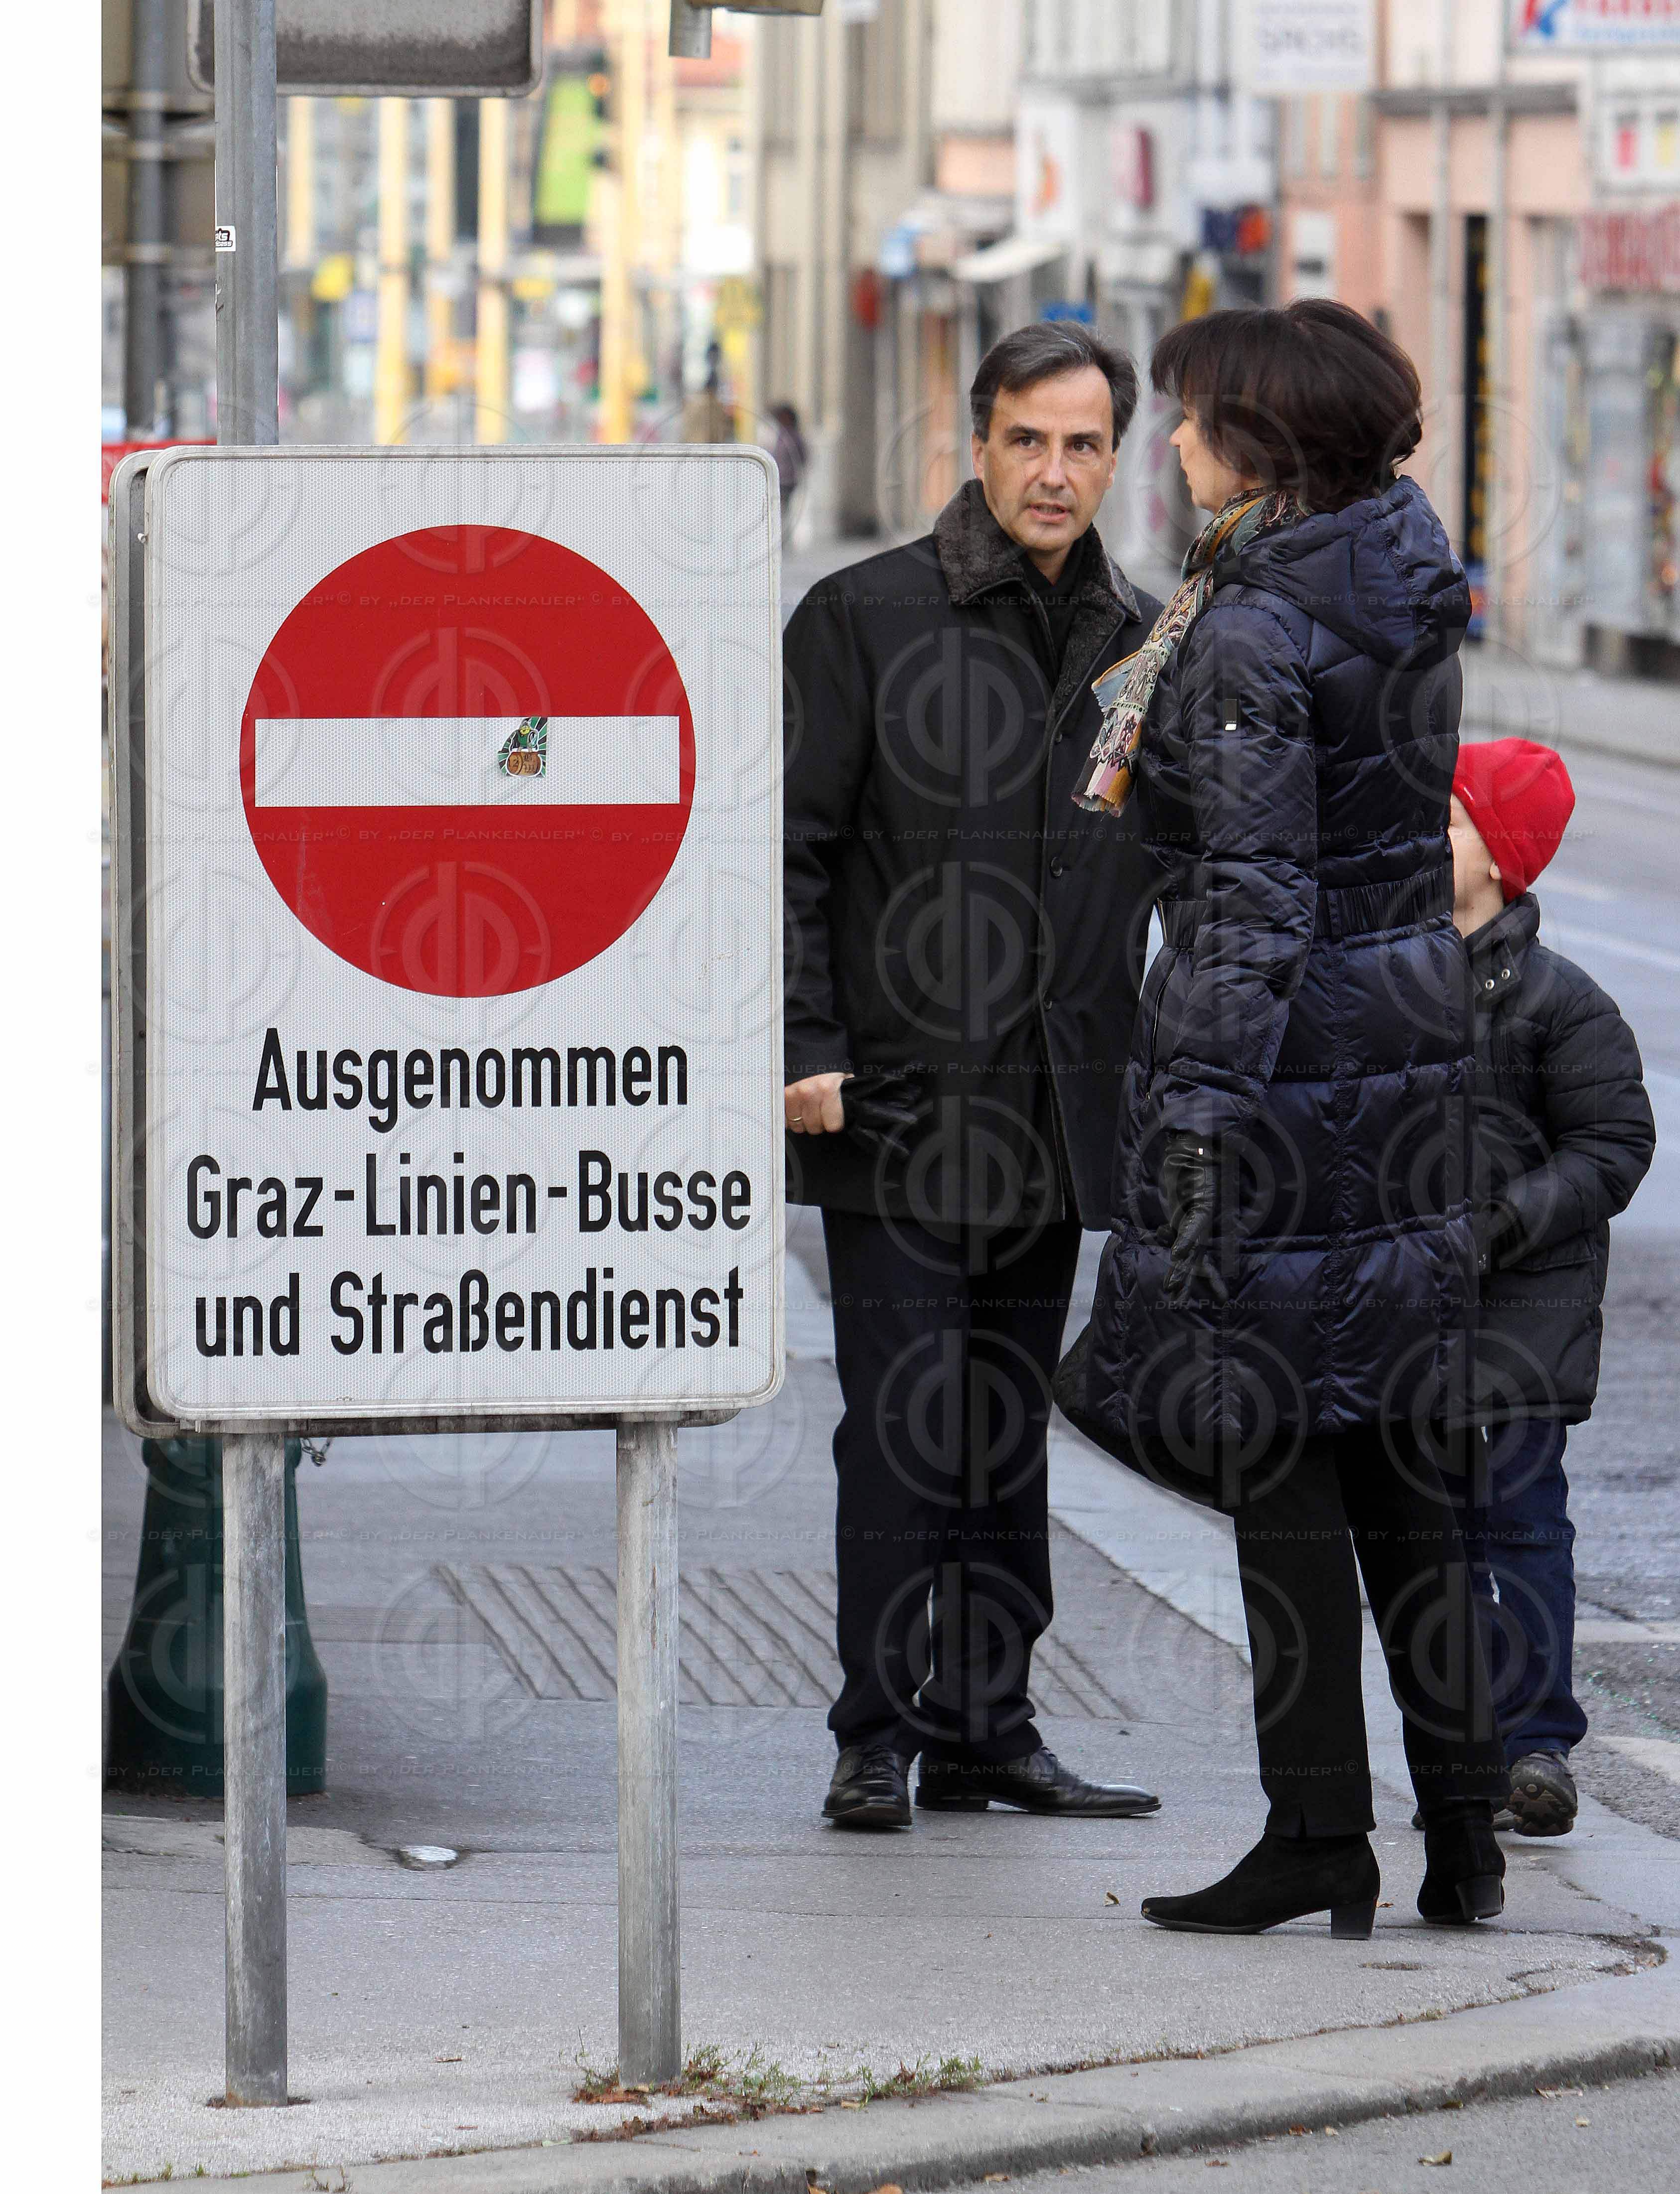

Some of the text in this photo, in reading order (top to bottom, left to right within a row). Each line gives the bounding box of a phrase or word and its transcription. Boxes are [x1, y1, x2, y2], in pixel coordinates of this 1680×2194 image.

[253, 1028, 687, 1133] Ausgenommen
[188, 1150, 750, 1239] Graz-Linien-Busse
[196, 1267, 743, 1357] und Straßendienst
